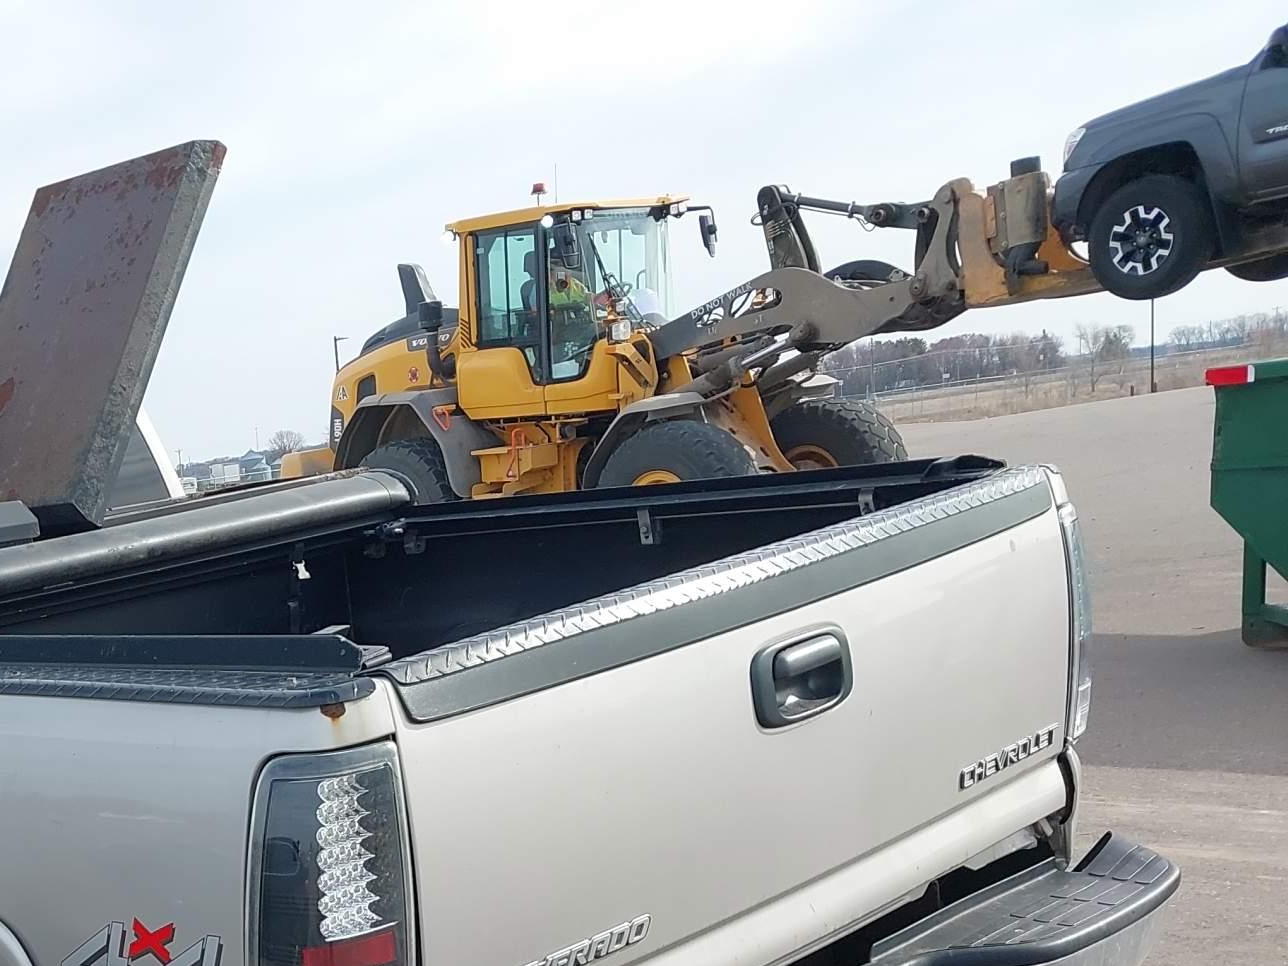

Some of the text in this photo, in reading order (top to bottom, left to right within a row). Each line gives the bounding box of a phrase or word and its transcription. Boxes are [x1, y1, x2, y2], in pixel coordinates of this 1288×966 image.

[691, 281, 753, 320] DO NOT WALK
[957, 721, 1060, 792] CHEVROLET
